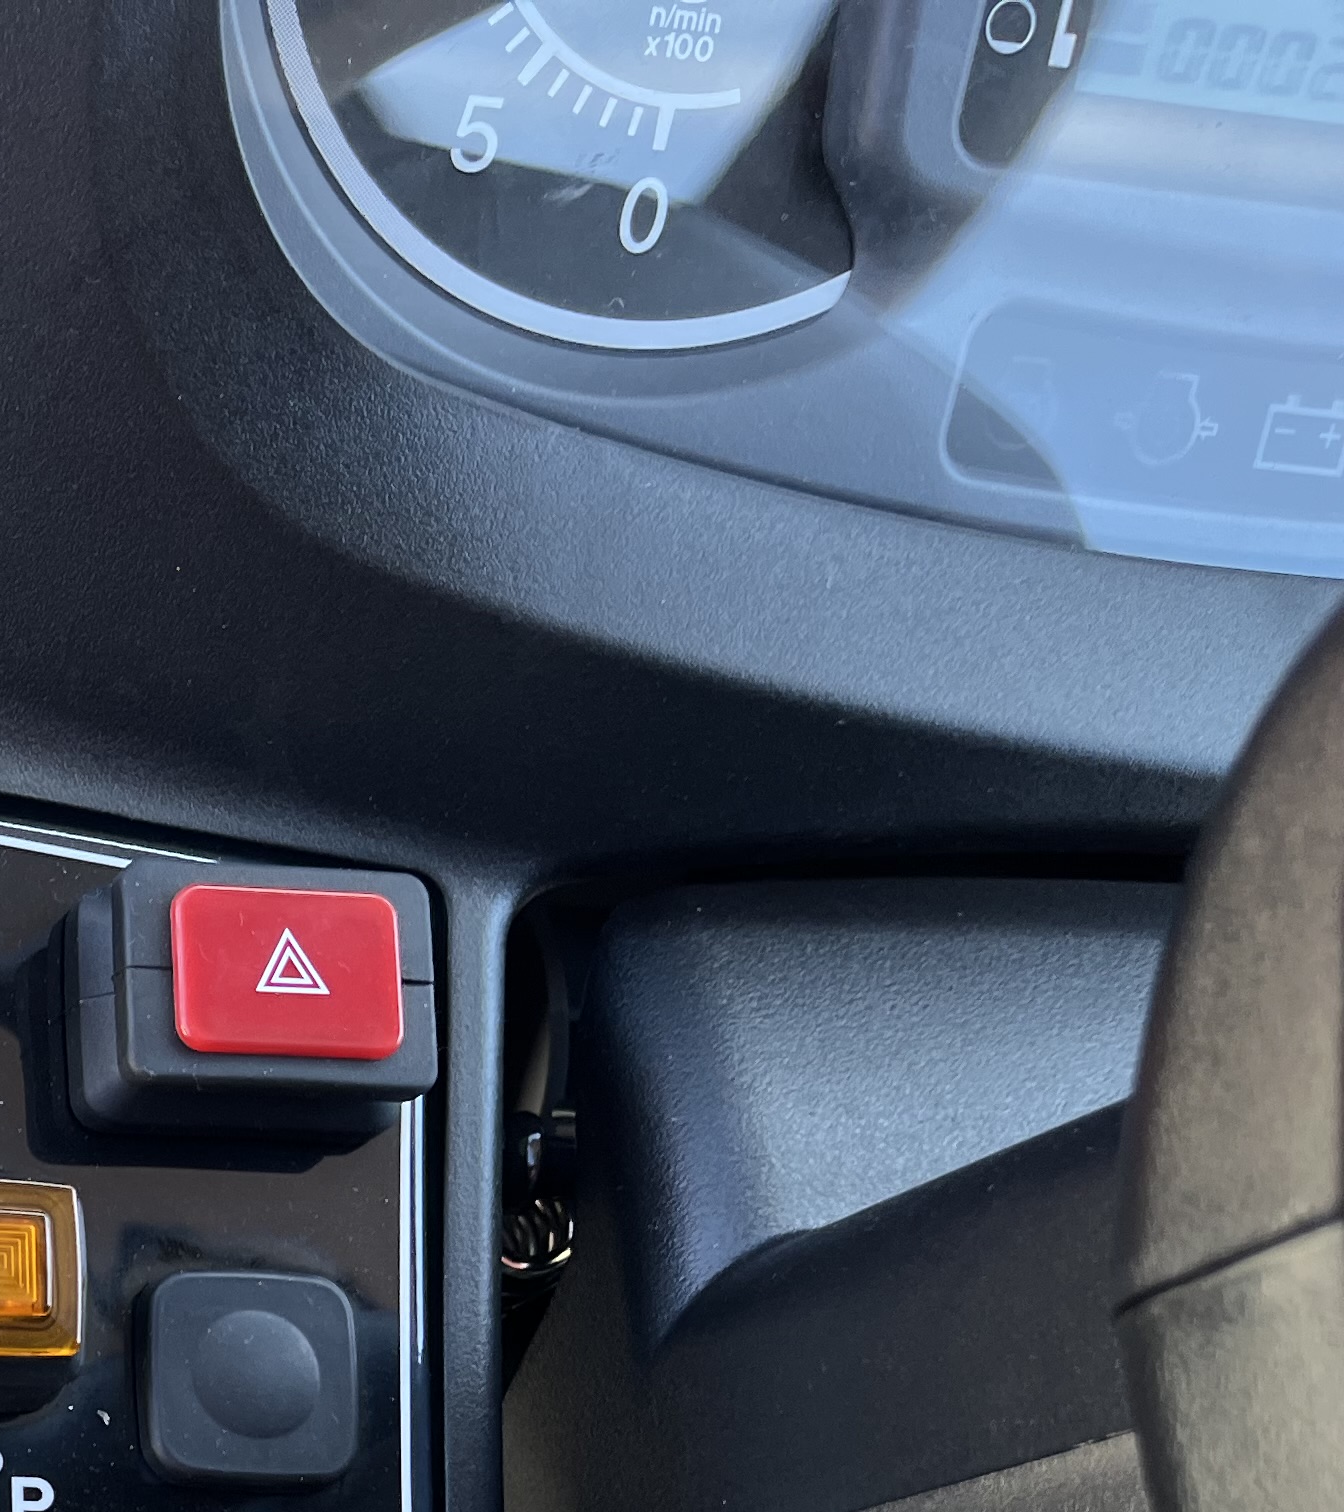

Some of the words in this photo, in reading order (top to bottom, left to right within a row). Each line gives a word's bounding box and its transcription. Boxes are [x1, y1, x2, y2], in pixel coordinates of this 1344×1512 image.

[649, 5, 721, 33] n/min
[644, 34, 714, 62] x100
[450, 95, 504, 173] 5
[619, 177, 668, 253] 0
